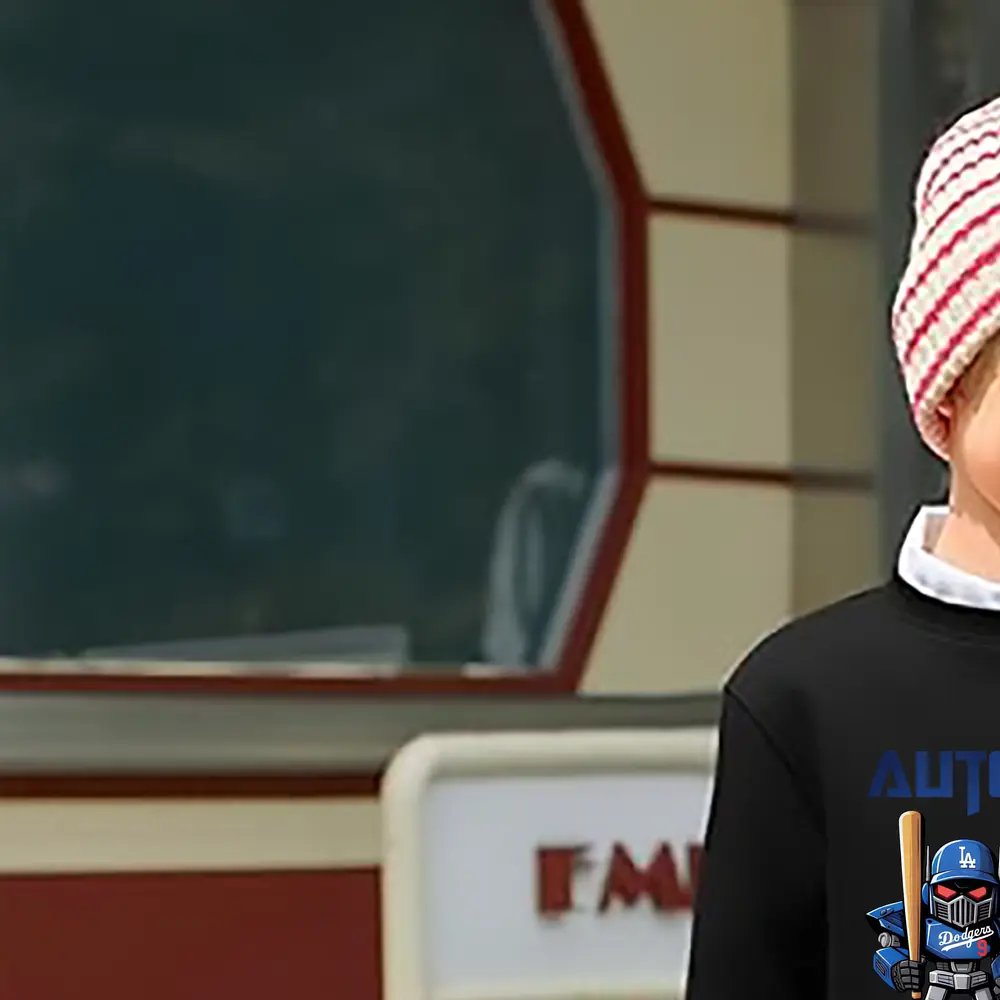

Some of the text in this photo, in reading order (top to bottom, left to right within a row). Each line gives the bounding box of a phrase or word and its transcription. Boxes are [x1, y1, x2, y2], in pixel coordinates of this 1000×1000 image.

[958, 846, 976, 869] LA
[938, 925, 995, 952] Dodgers
[976, 939, 989, 957] 9
